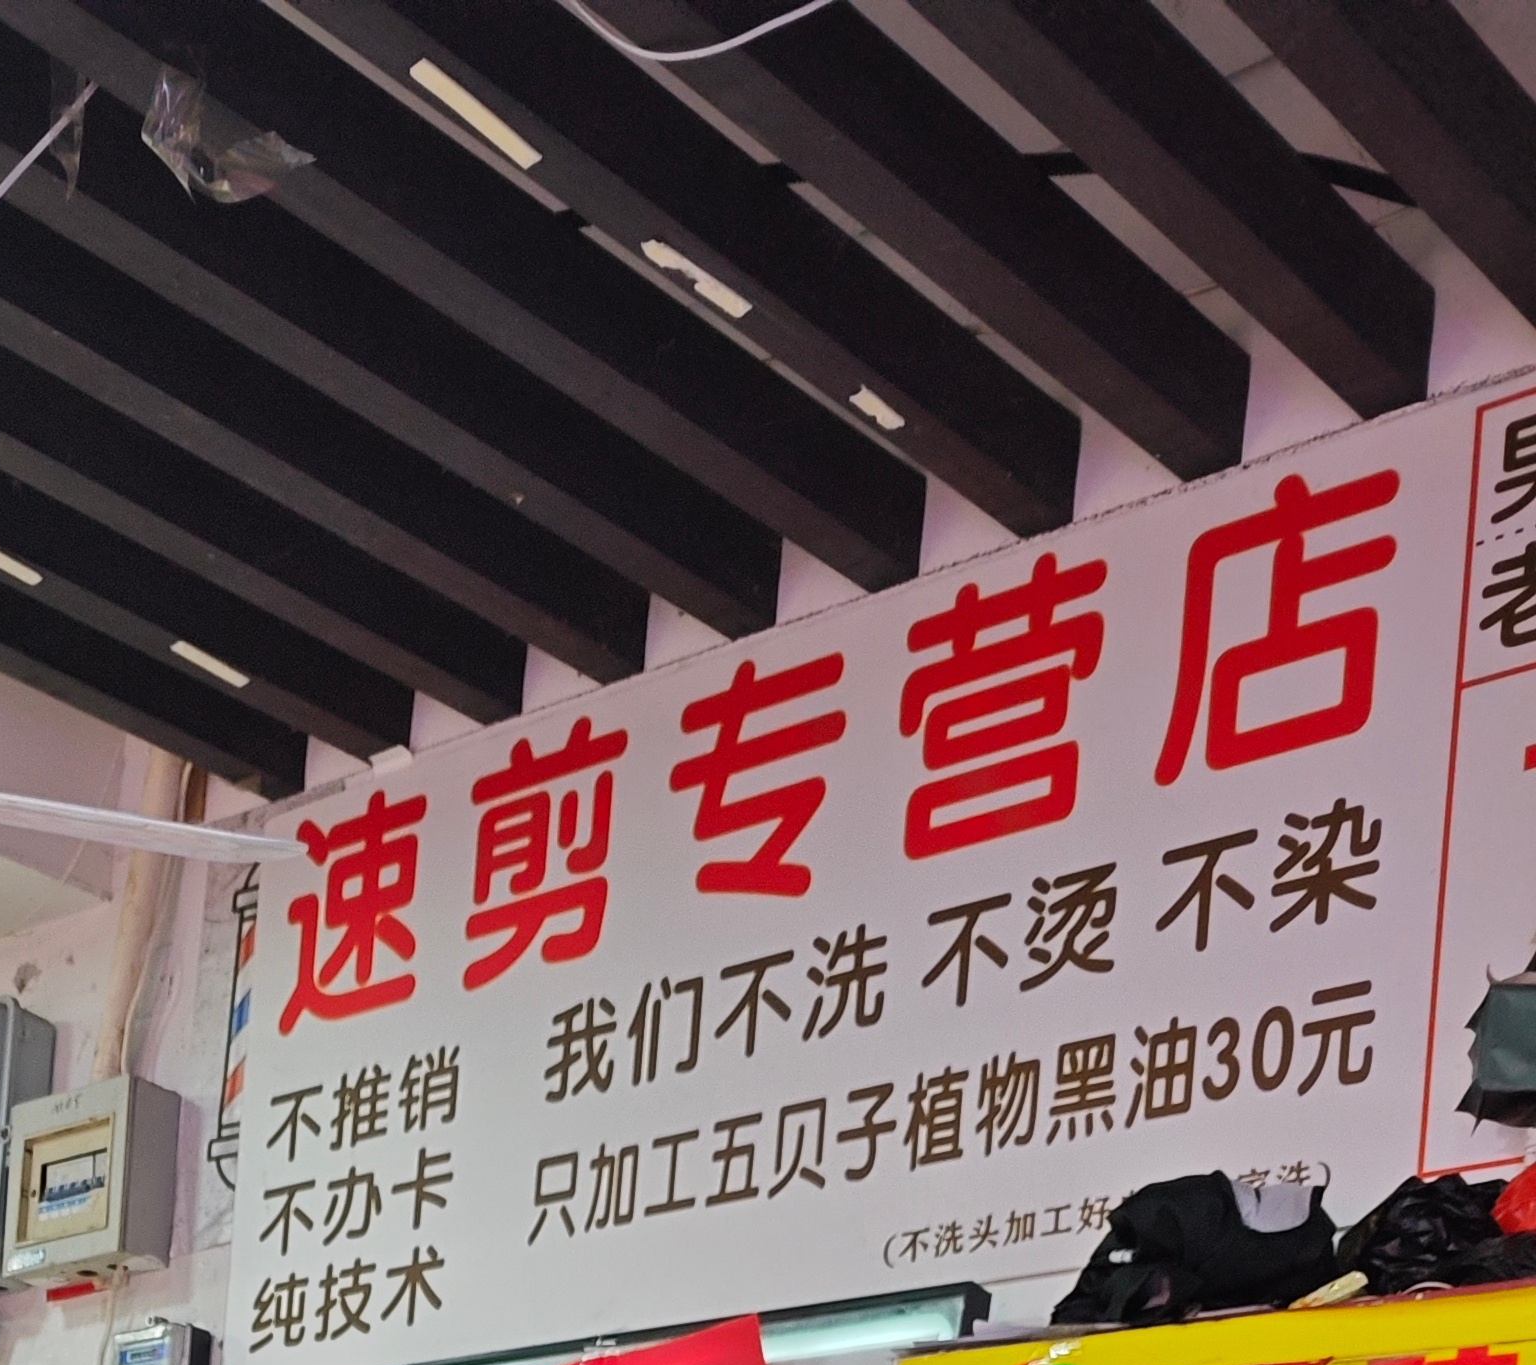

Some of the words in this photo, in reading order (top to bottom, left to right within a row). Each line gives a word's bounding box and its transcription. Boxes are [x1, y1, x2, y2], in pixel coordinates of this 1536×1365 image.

[279, 473, 1401, 1036] 速剪专营店
[544, 923, 888, 1102] 我们不洗
[921, 861, 1117, 1007] 不烫
[1155, 798, 1382, 952] 不染
[266, 1045, 460, 1162] 不推销
[527, 980, 1376, 1246] 只加工五贝子植物黑油30元
[259, 1147, 454, 1256] 不办卡
[249, 1245, 445, 1353] 纯技术
